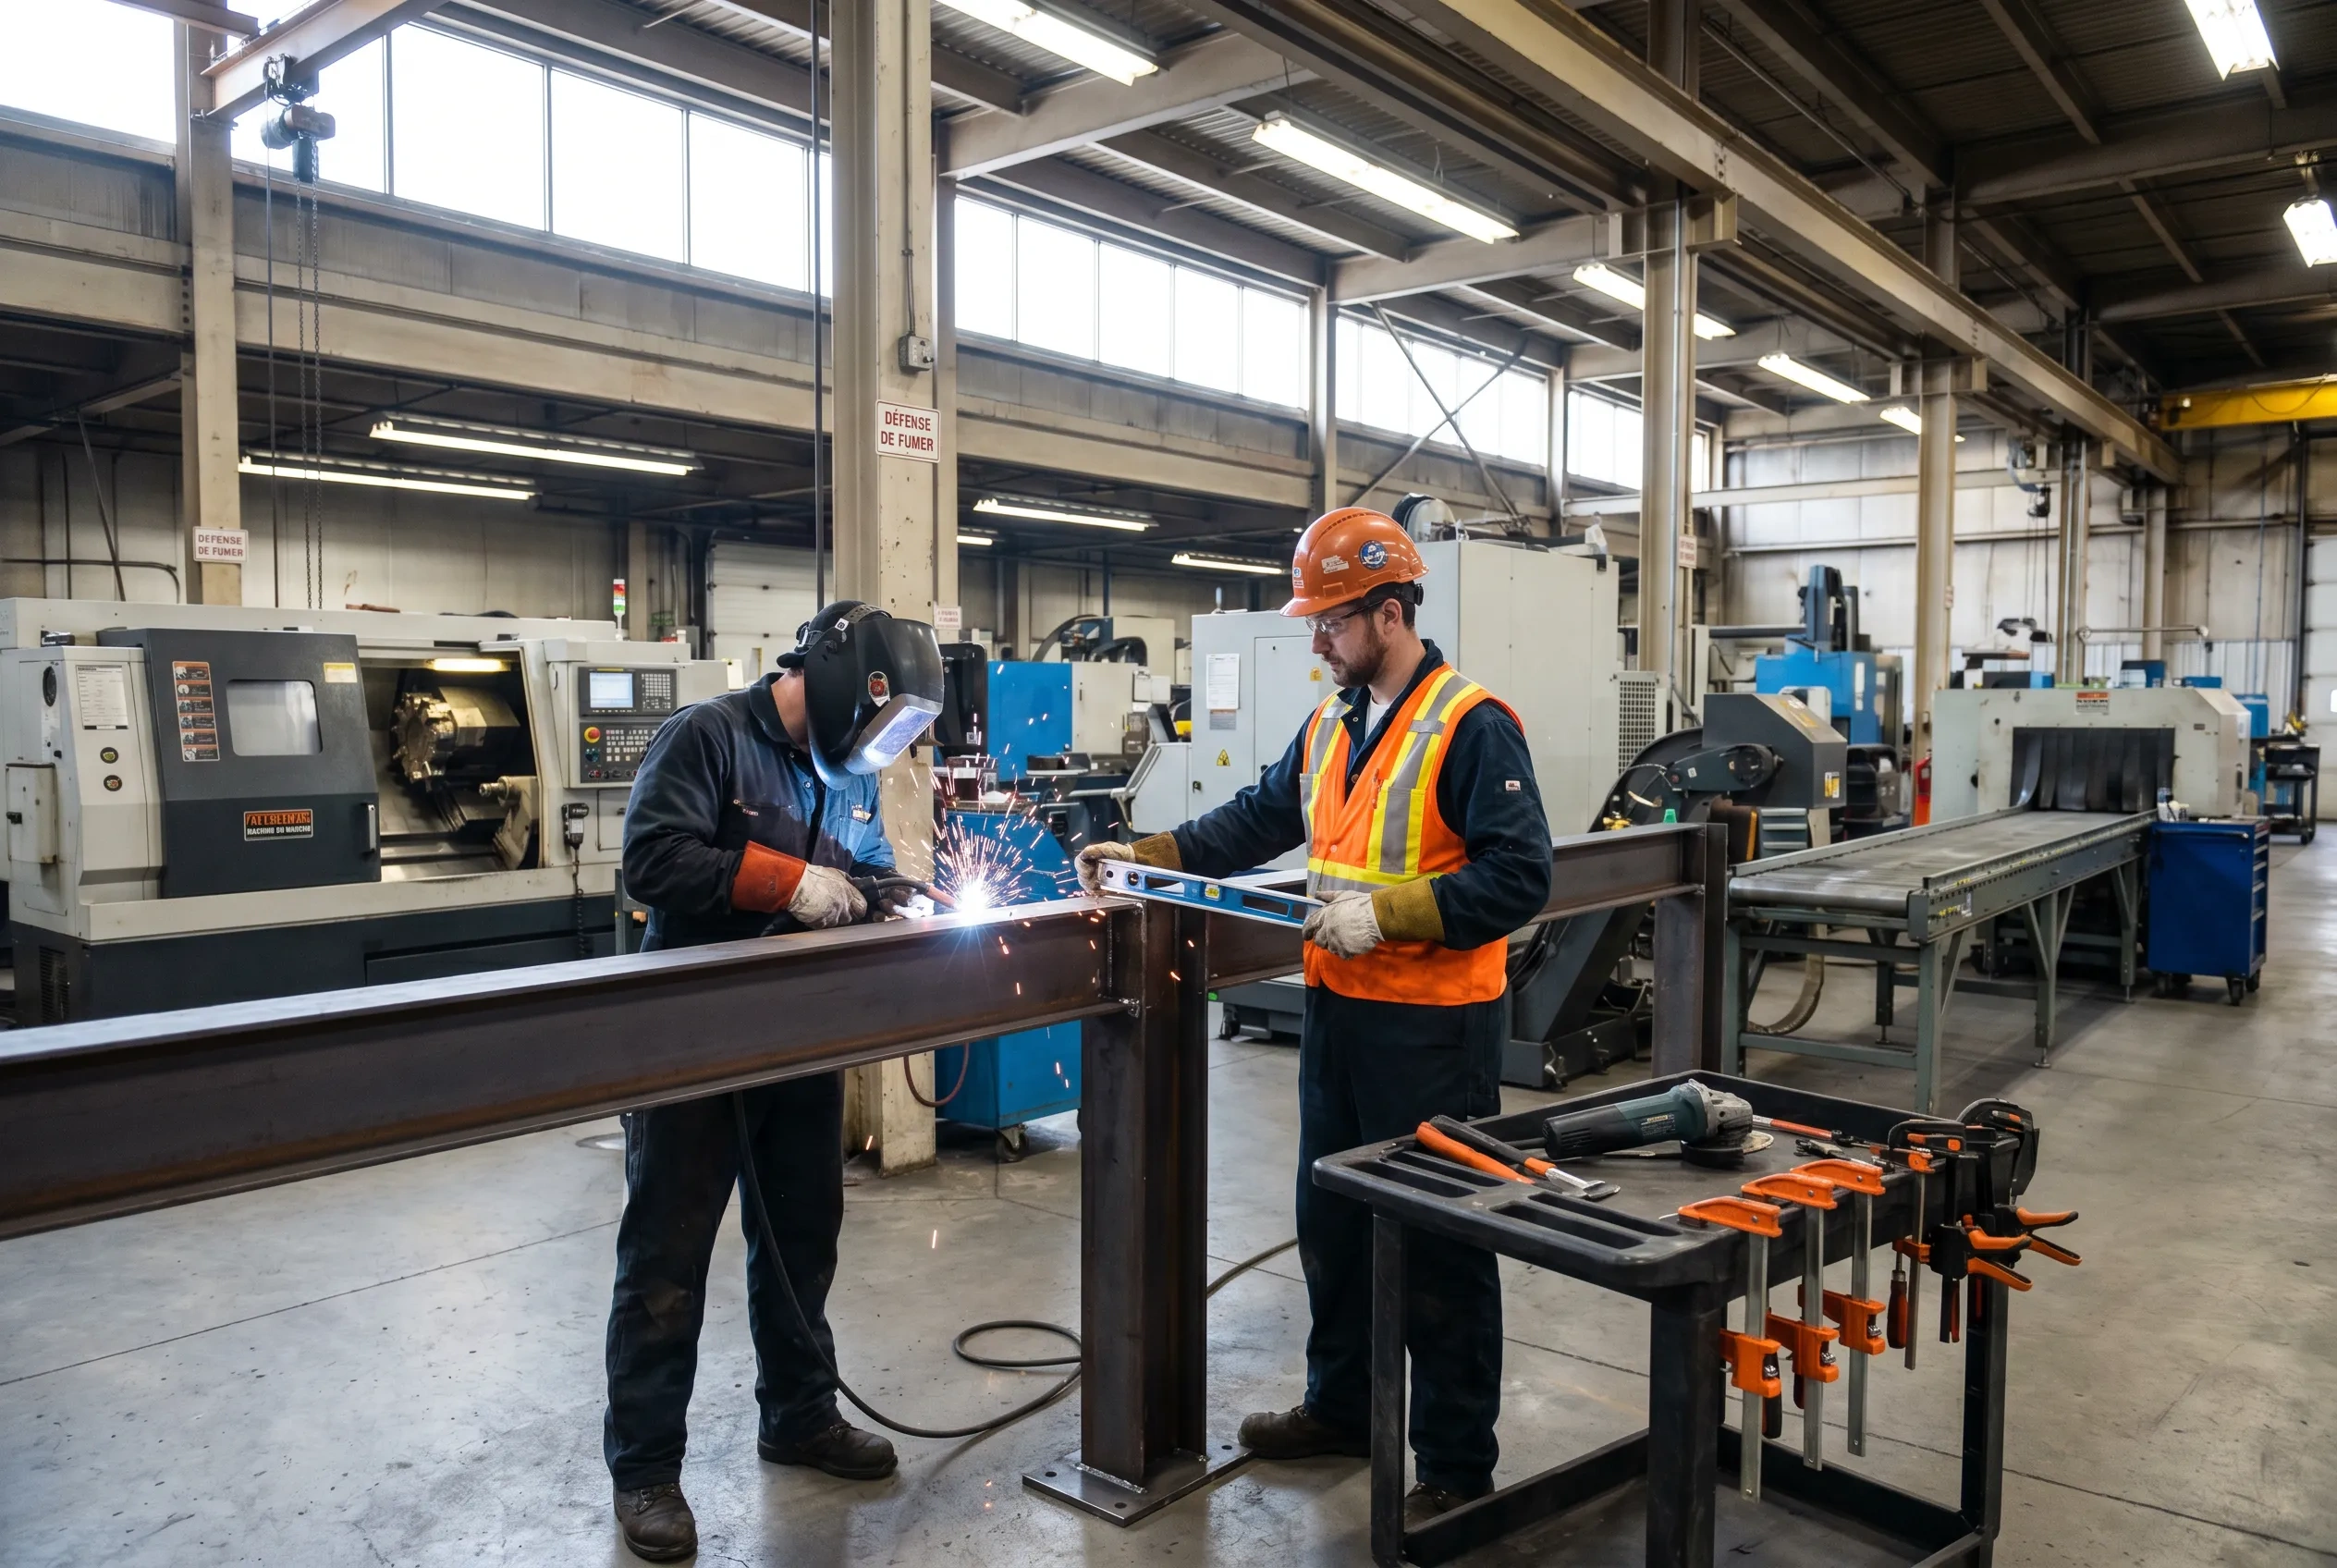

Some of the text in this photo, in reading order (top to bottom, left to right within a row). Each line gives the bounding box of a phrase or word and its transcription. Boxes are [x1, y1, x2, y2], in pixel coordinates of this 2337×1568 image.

[885, 409, 931, 432] DÉFENSE
[881, 431, 934, 451] DE FUMER
[198, 546, 243, 557] DE FUMER
